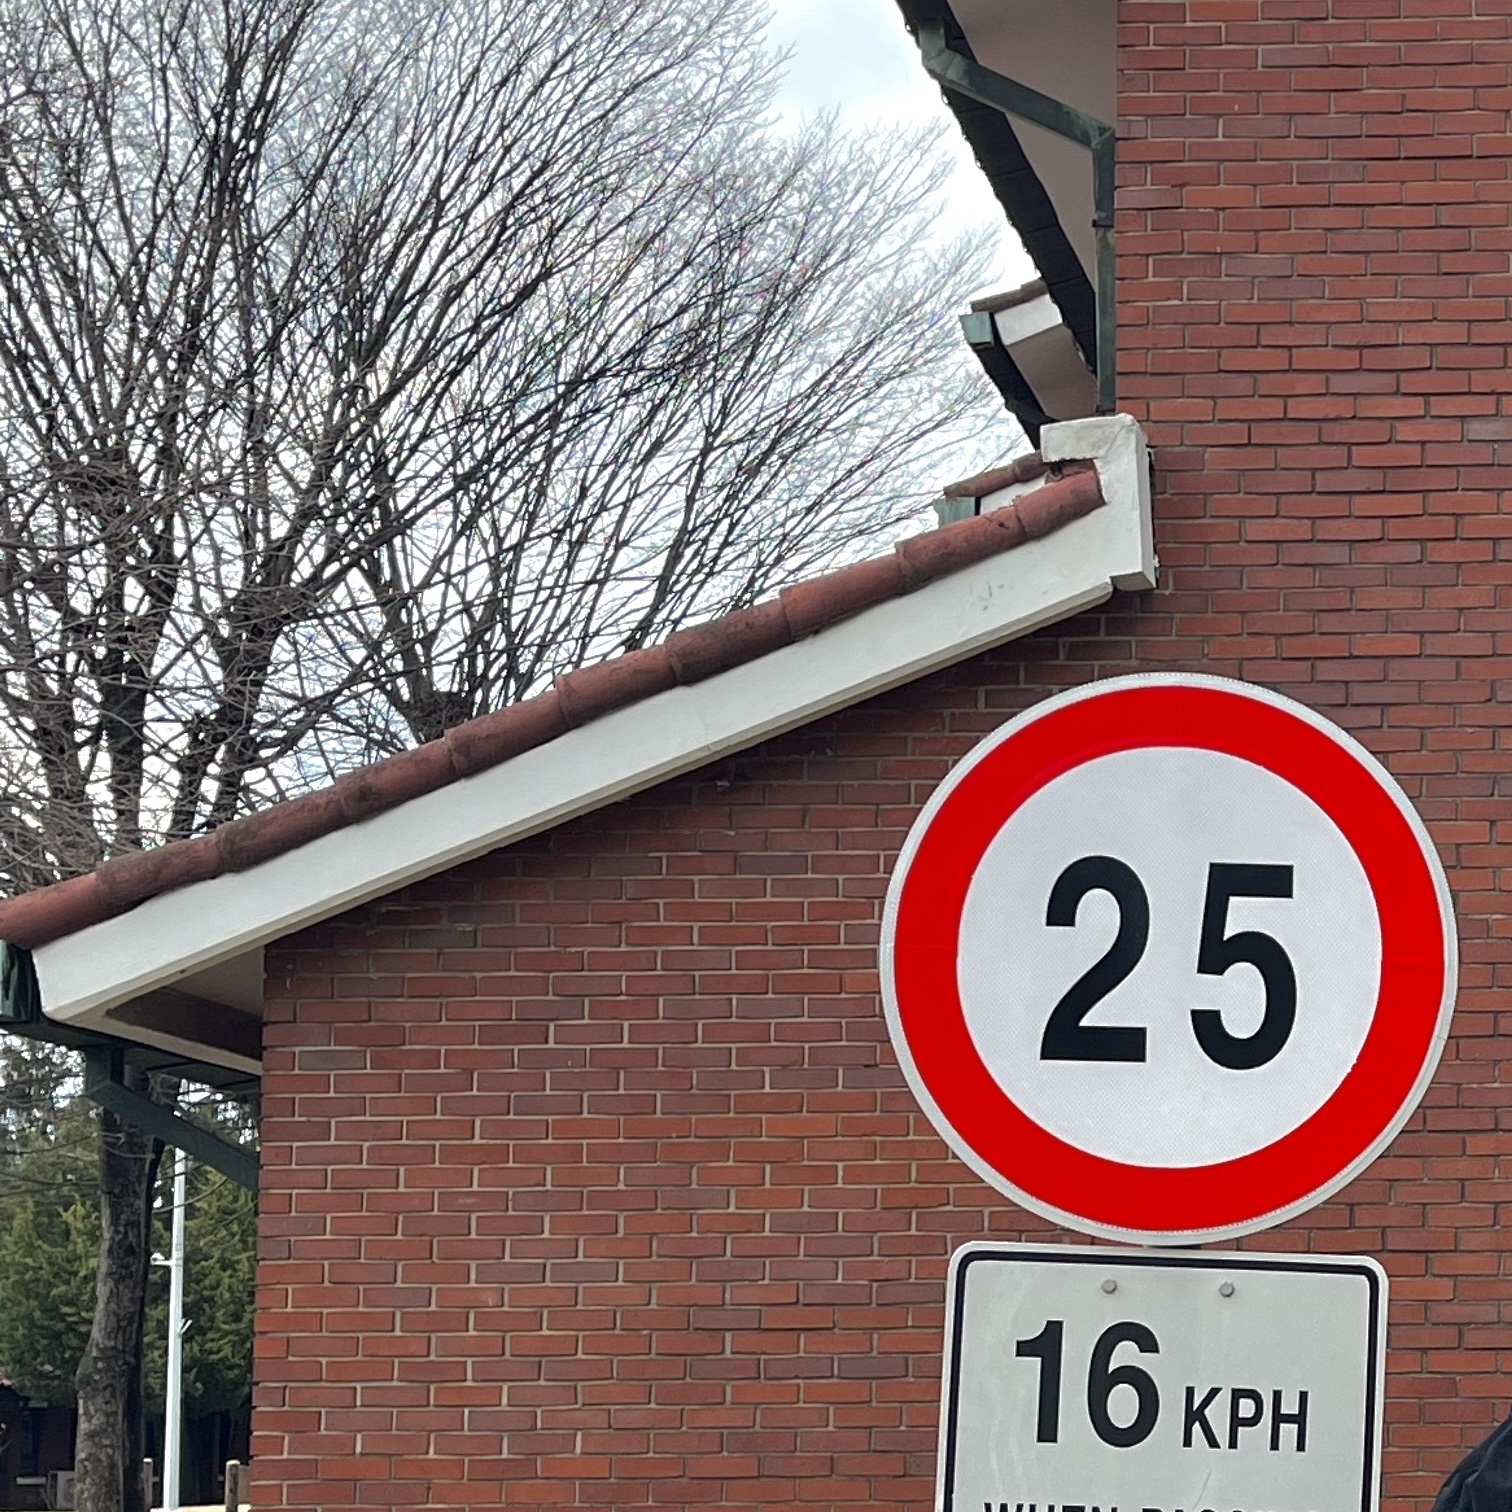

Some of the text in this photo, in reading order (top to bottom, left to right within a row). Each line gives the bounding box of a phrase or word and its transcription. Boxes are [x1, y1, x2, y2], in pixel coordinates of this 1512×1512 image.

[1039, 855, 1297, 1071] 25
[1014, 1319, 1309, 1453] 16 KPH
